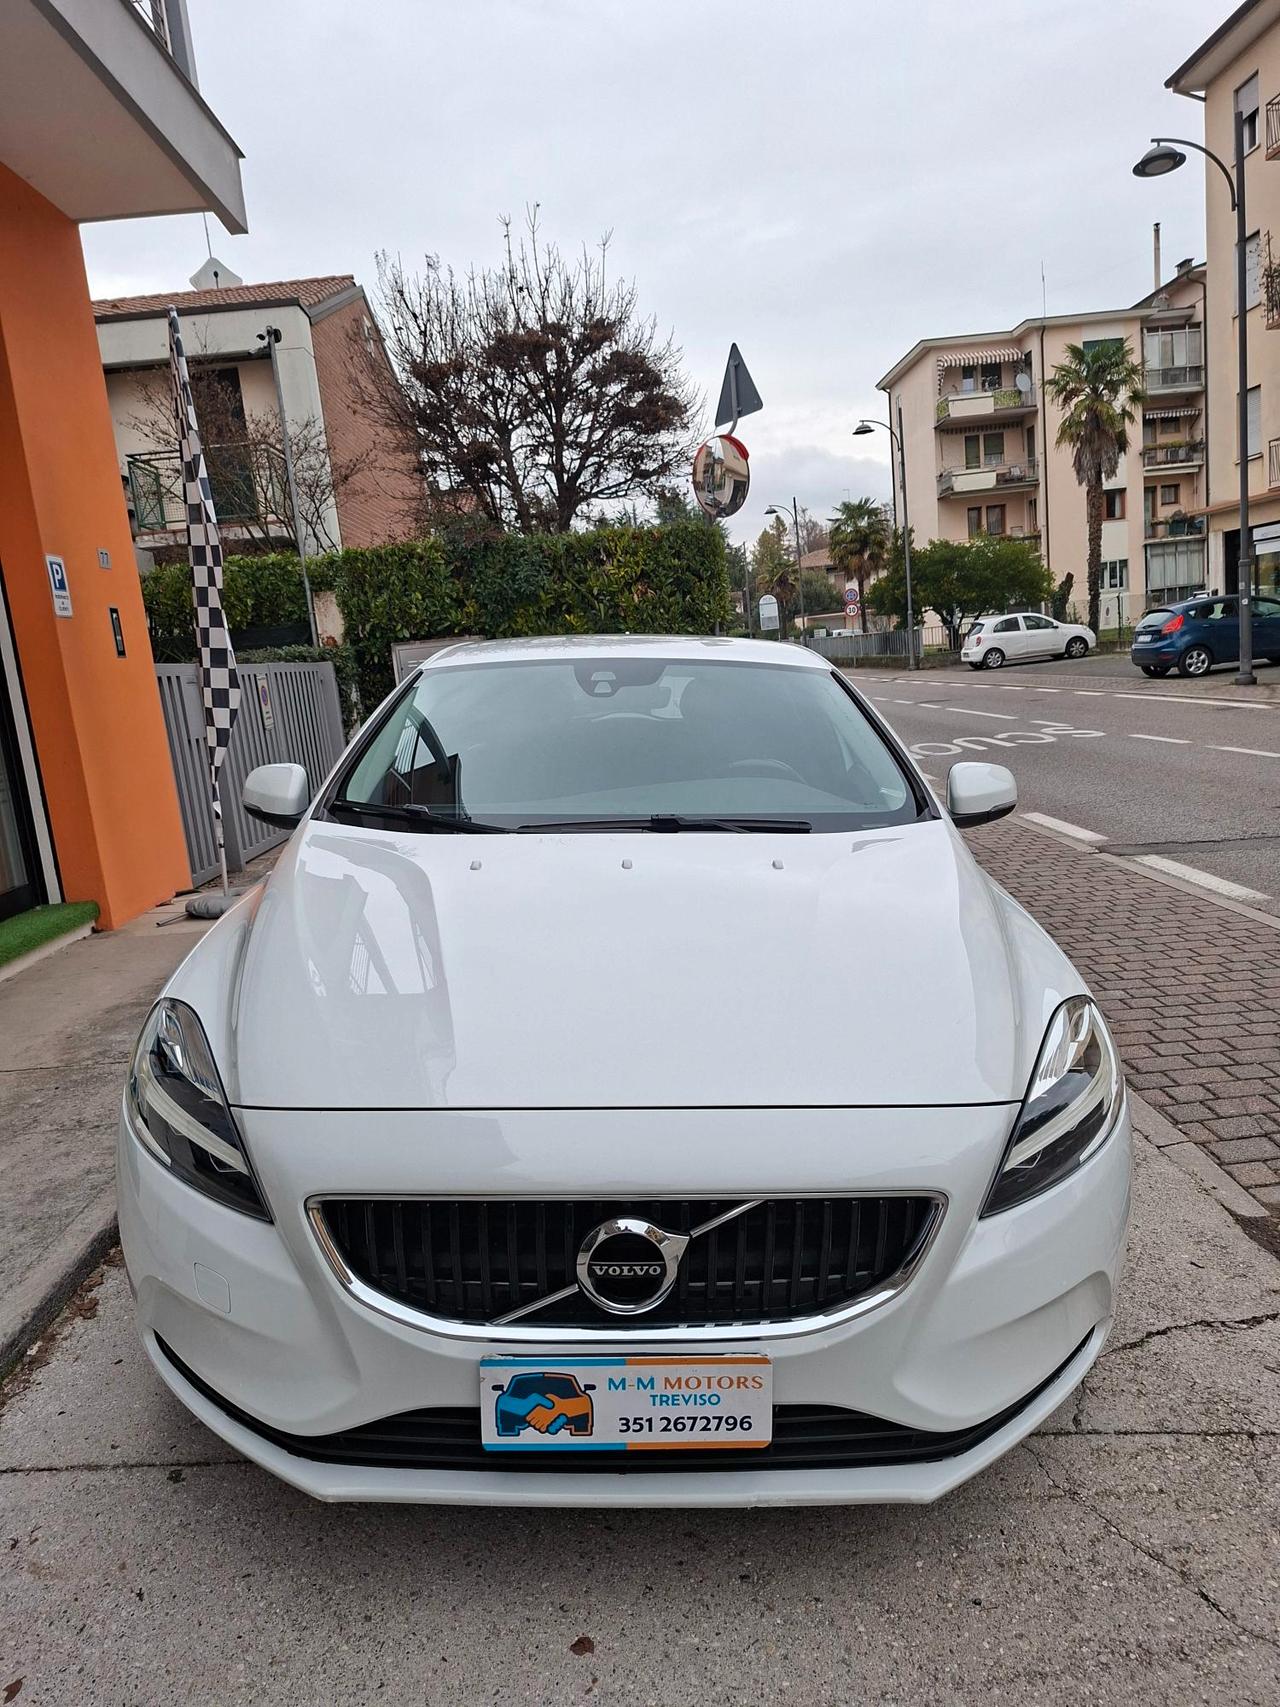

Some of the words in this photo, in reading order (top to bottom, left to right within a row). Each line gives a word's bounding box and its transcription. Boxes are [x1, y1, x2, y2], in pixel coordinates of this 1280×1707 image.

[52, 564, 62, 588] P
[592, 1266, 661, 1276] VOLVO
[607, 1376, 655, 1391] M-M
[663, 1375, 763, 1390] MOTORS
[649, 1393, 721, 1407] TREVISO
[618, 1416, 653, 1433] 351
[659, 1415, 753, 1432] 2672796
